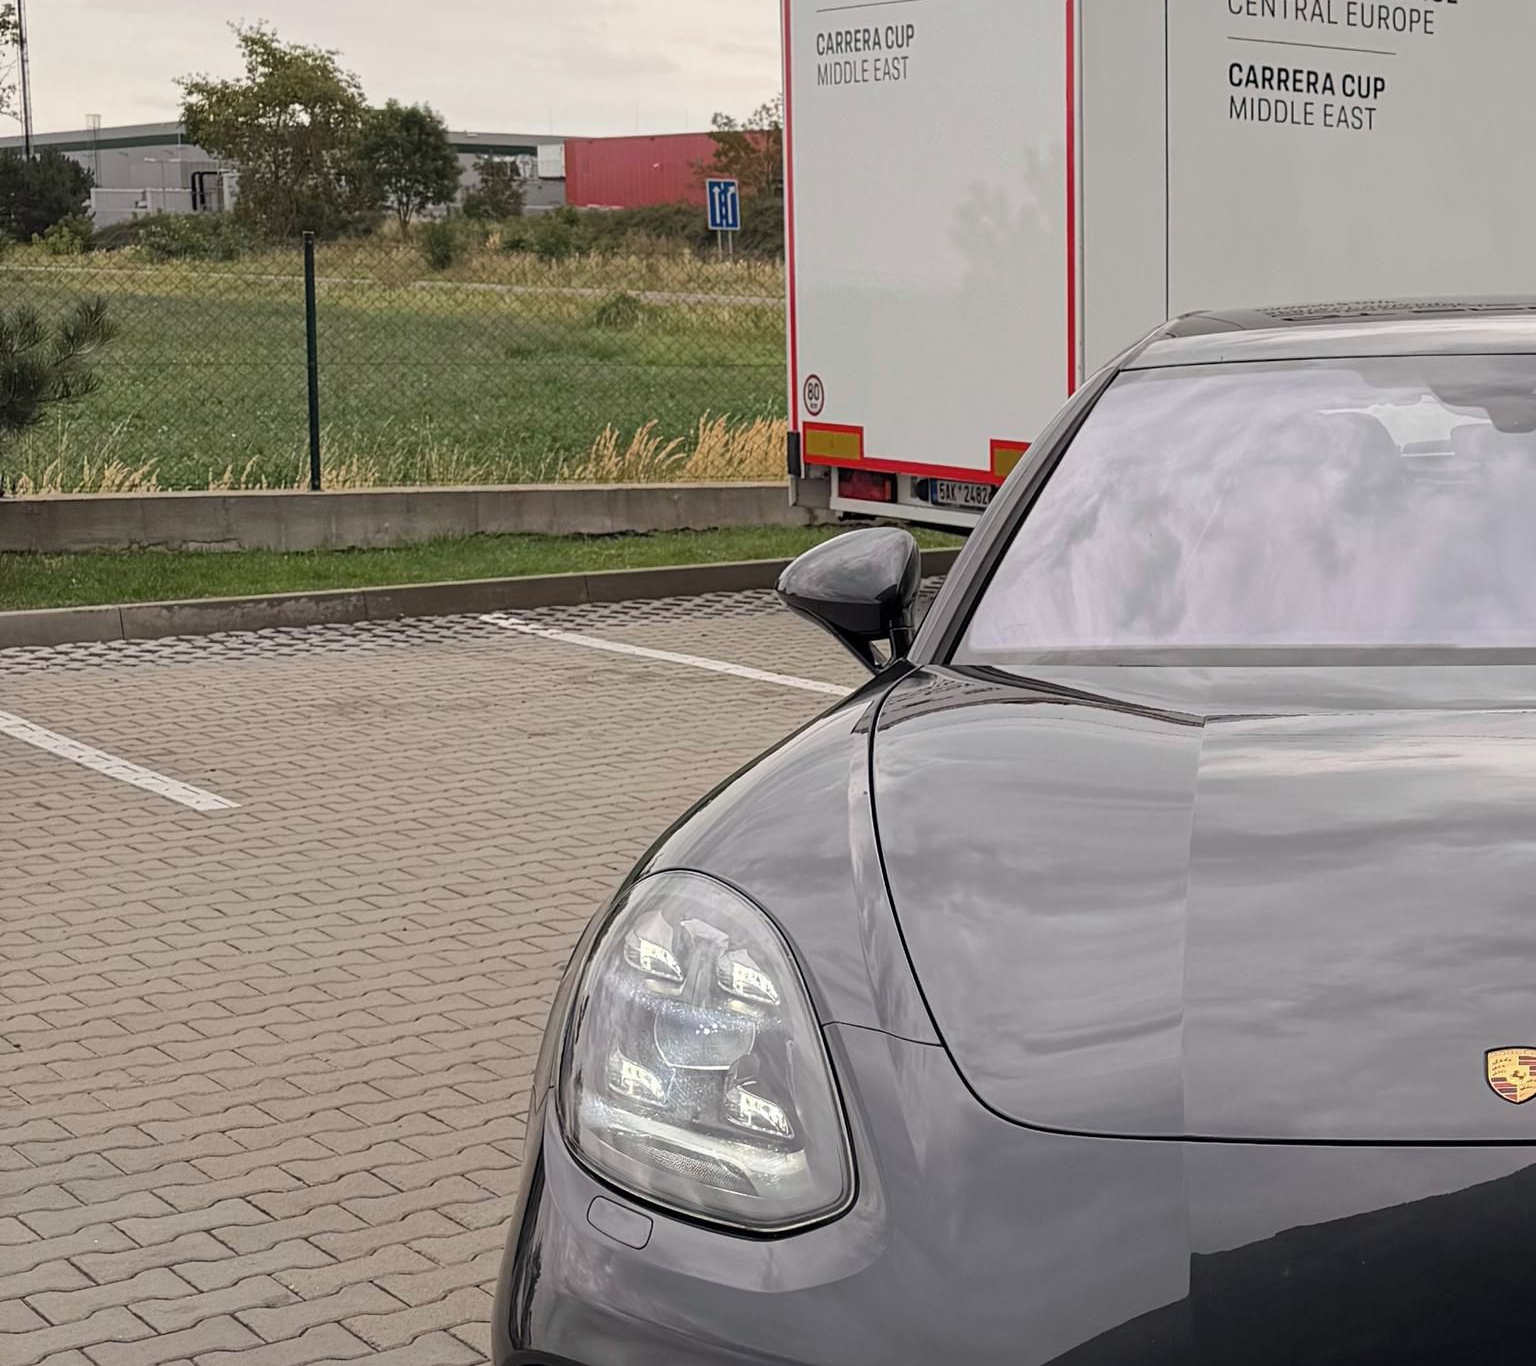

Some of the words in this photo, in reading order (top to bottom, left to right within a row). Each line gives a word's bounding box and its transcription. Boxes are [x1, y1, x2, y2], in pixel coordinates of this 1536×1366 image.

[1346, 1, 1435, 35] EUROPE
[816, 28, 882, 56] CARRERA
[885, 24, 915, 49] CUP
[817, 60, 869, 86] MIDDLE
[874, 56, 909, 81] EAST
[1228, 63, 1335, 96] CARRERA
[1342, 74, 1386, 99] CUP
[1229, 96, 1315, 127] MIDDLE
[1324, 103, 1376, 130] EAST
[807, 382, 820, 401] 80
[964, 485, 988, 505] 2482
